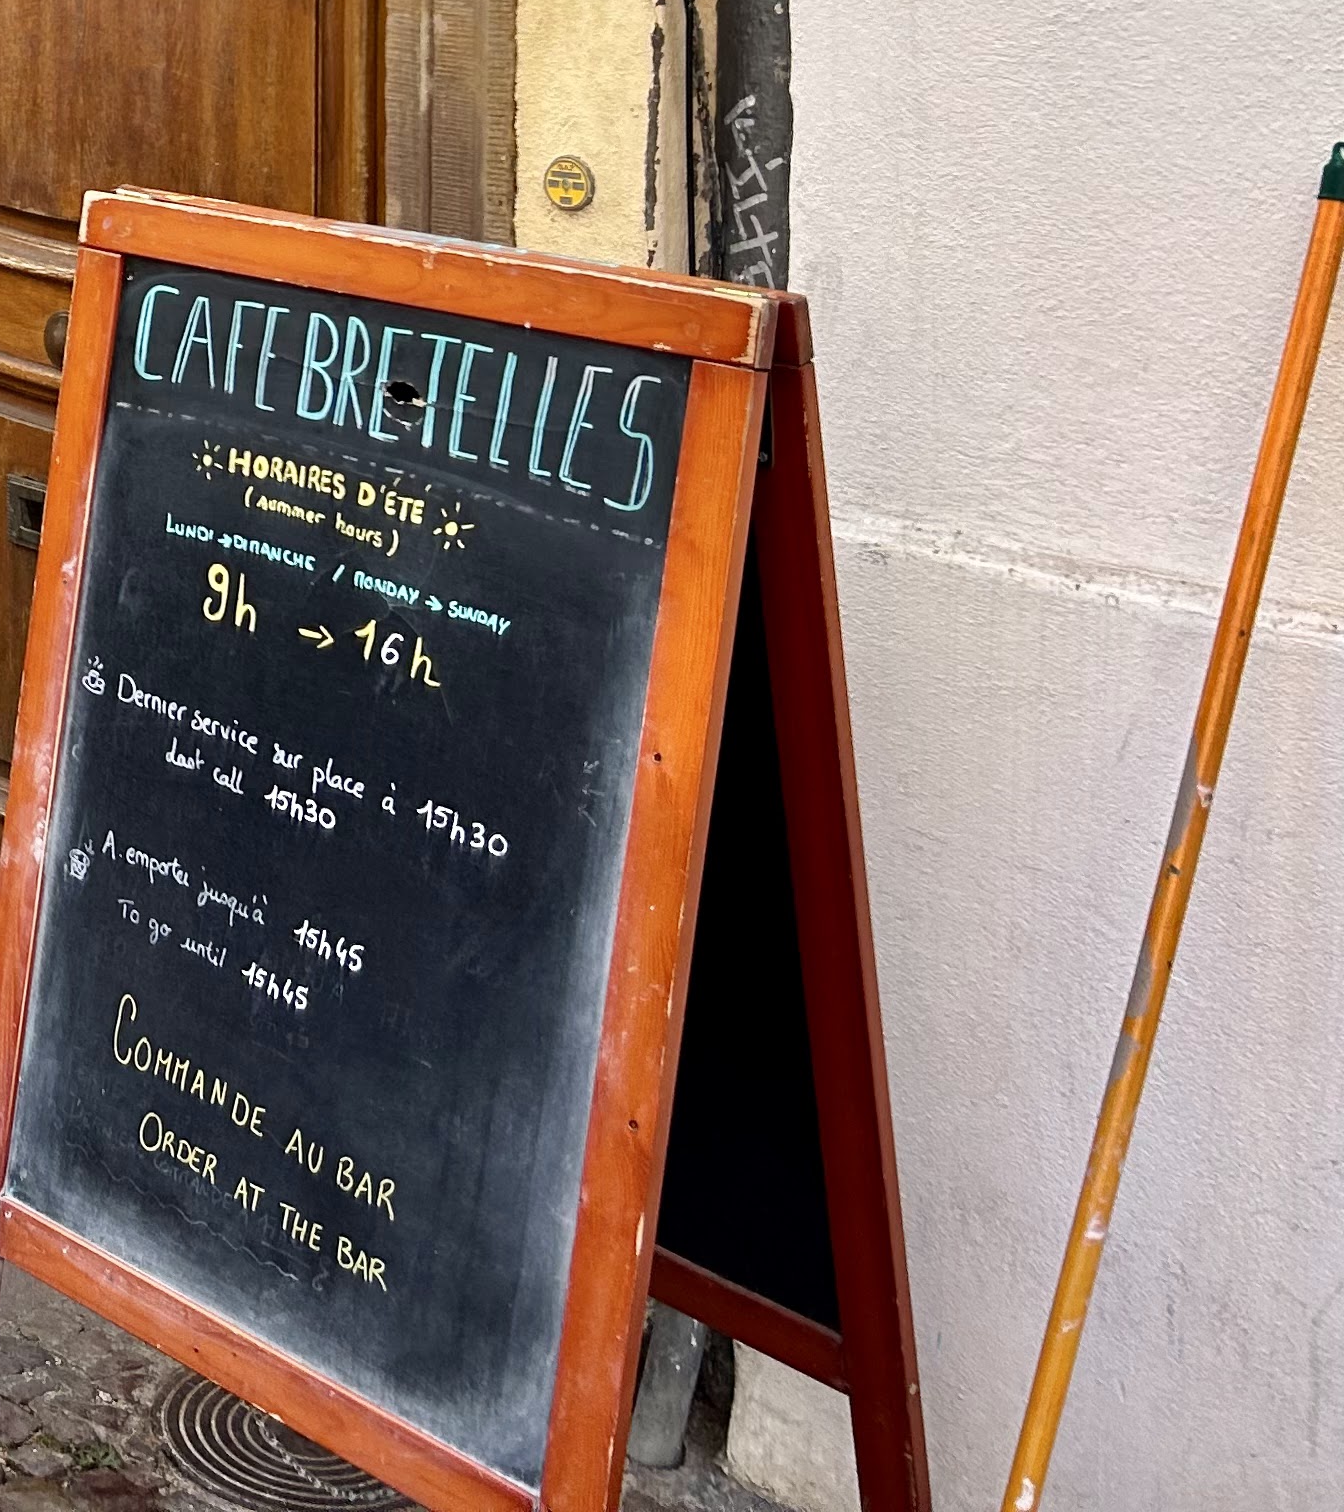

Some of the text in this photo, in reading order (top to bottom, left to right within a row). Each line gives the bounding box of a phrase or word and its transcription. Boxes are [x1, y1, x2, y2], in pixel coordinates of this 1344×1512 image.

[133, 284, 662, 514] CAFE BRETELLES
[227, 447, 346, 501] HORAIRES
[203, 563, 442, 688] 9h 16h
[232, 534, 316, 571] DIMANCHE
[353, 570, 420, 606] MONDAY
[447, 600, 511, 636] SUNDAY
[116, 674, 187, 722] Dernier
[190, 709, 259, 755] service
[272, 743, 304, 769] sur
[312, 758, 365, 800] place
[416, 800, 509, 857] 15h30
[212, 766, 245, 795] call
[264, 785, 336, 830] 15h30
[117, 898, 309, 1010] To go until 15h45
[293, 920, 365, 972] 15h45
[112, 994, 395, 1221] COMMANDE AU BAR
[139, 1112, 218, 1185] ORDER
[233, 1177, 265, 1212] AT
[279, 1202, 323, 1252] THE
[336, 1236, 387, 1291] BAR
